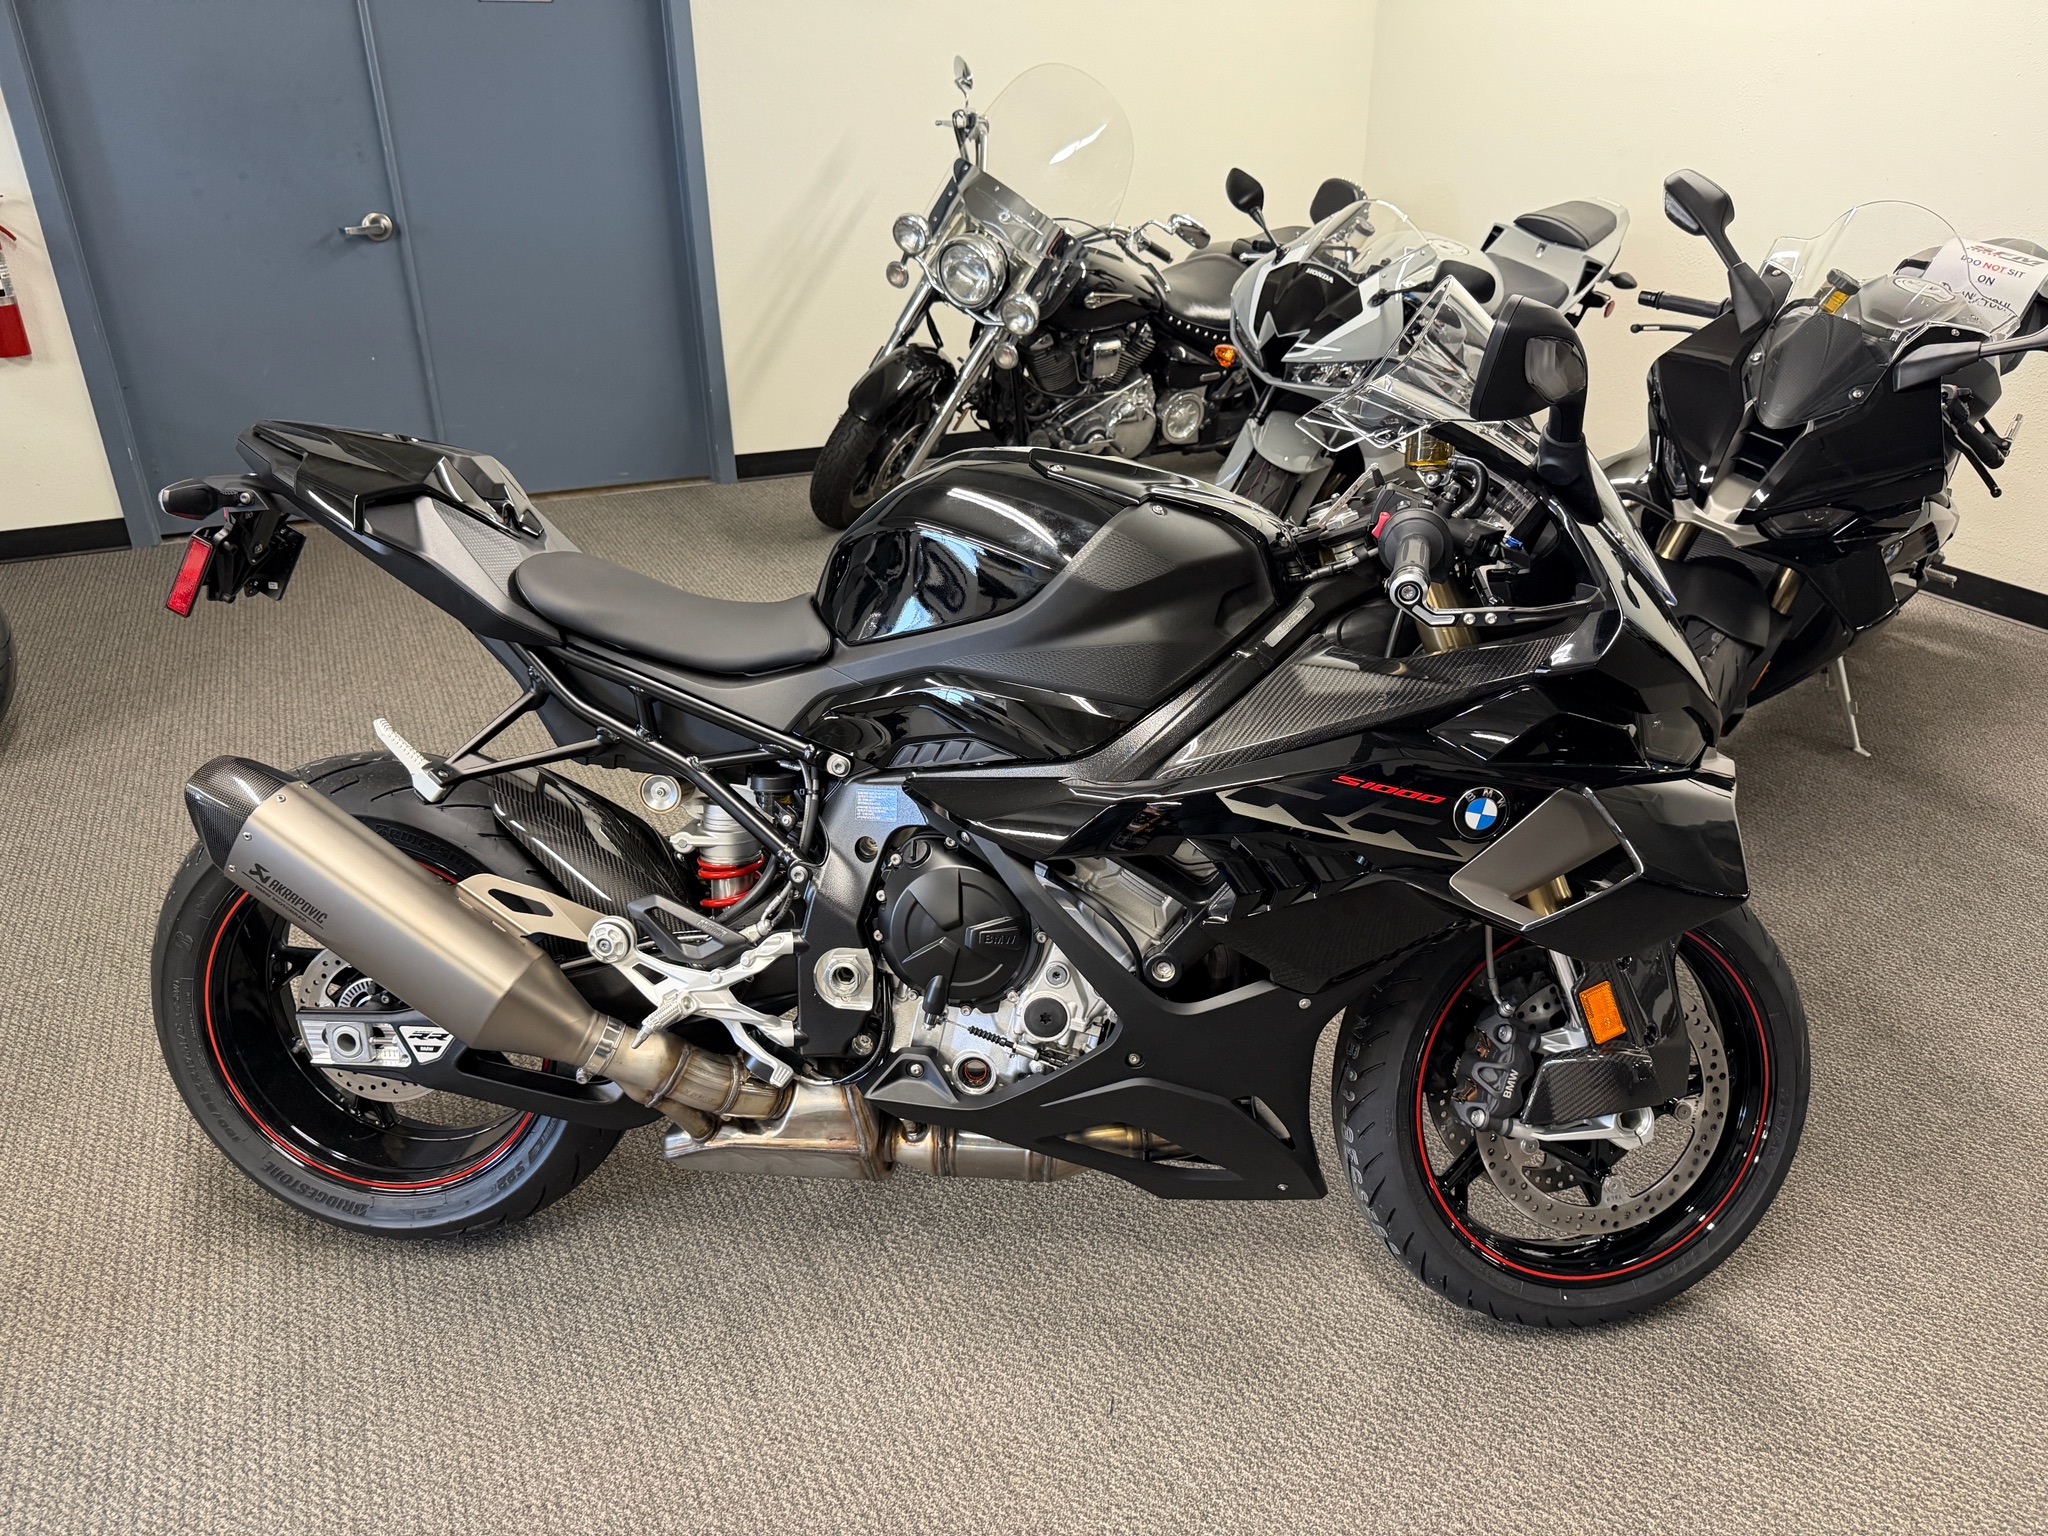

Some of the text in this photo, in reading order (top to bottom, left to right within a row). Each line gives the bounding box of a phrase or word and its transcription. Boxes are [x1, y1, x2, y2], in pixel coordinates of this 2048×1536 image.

[1305, 267, 1334, 284] HONDA
[1982, 262, 2008, 274] NOT
[2007, 268, 2026, 279] SIT
[1977, 274, 1996, 286] ON
[1332, 775, 1447, 804] S1000
[984, 934, 1016, 945] BMW
[1502, 1068, 1519, 1099] BMW
[259, 1160, 370, 1216] BRIDGESTONE
